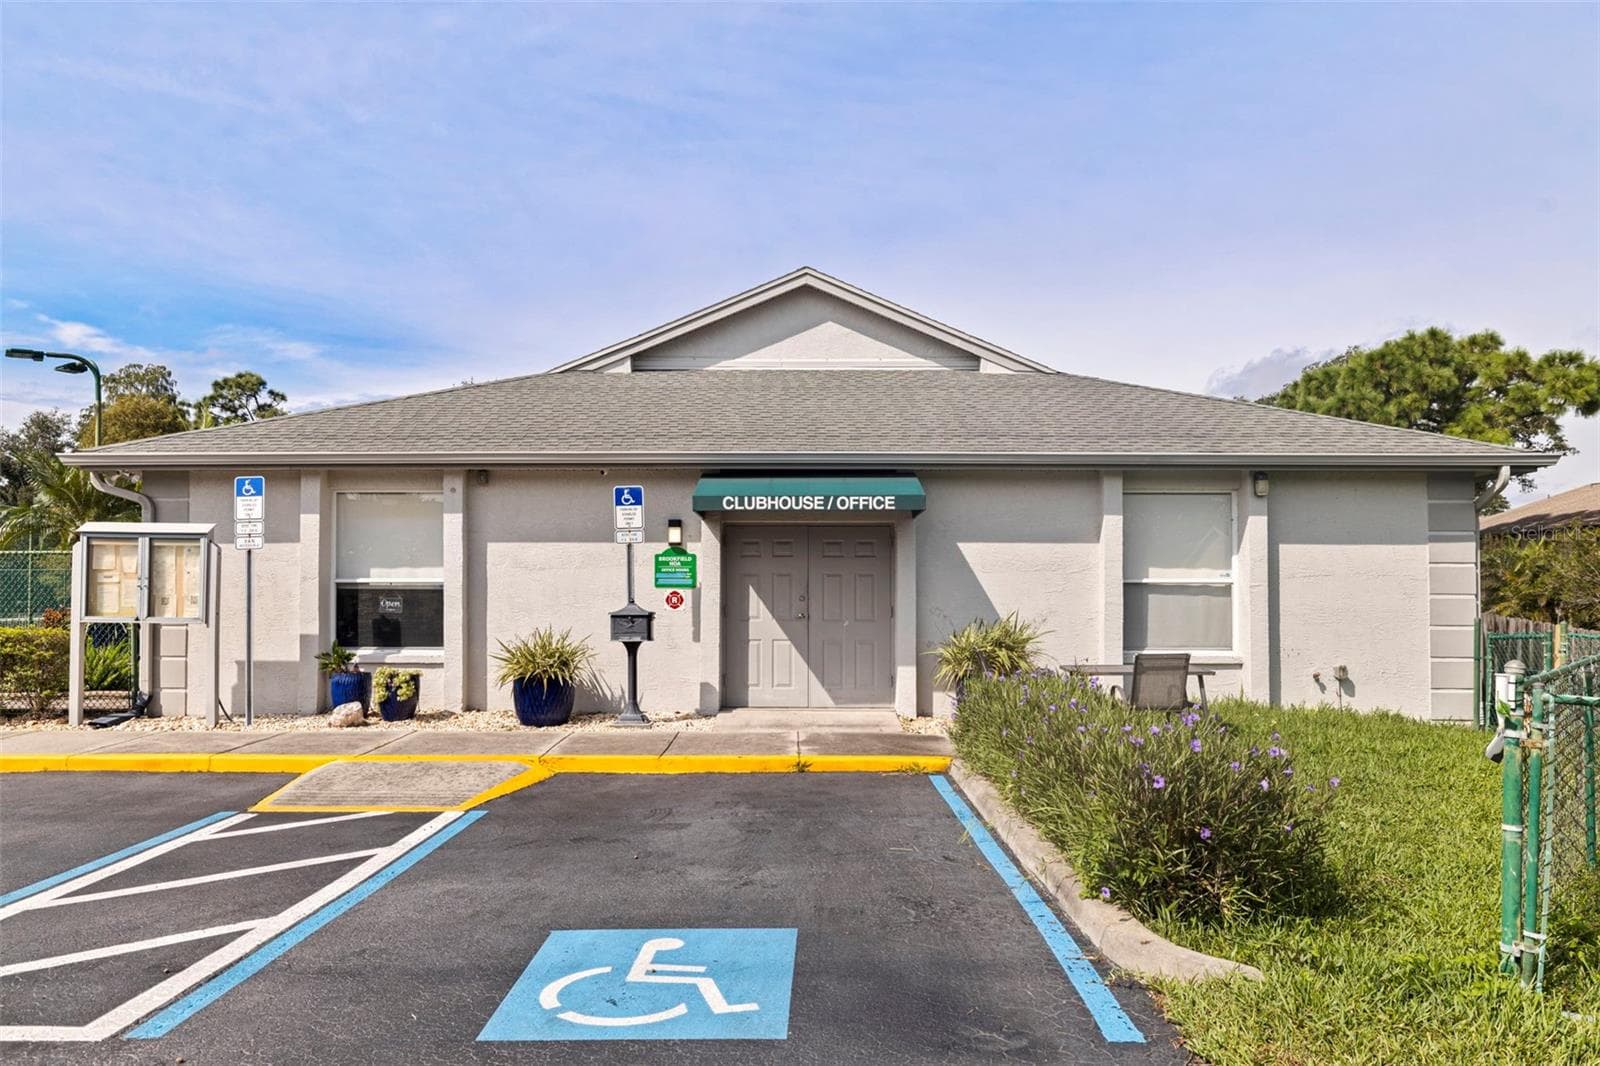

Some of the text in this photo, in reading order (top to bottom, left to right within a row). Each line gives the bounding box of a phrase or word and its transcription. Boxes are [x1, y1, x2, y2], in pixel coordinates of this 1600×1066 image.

[722, 495, 824, 510] CLUBHOUSE
[836, 495, 896, 510] OFFICE
[380, 599, 400, 608] Open
